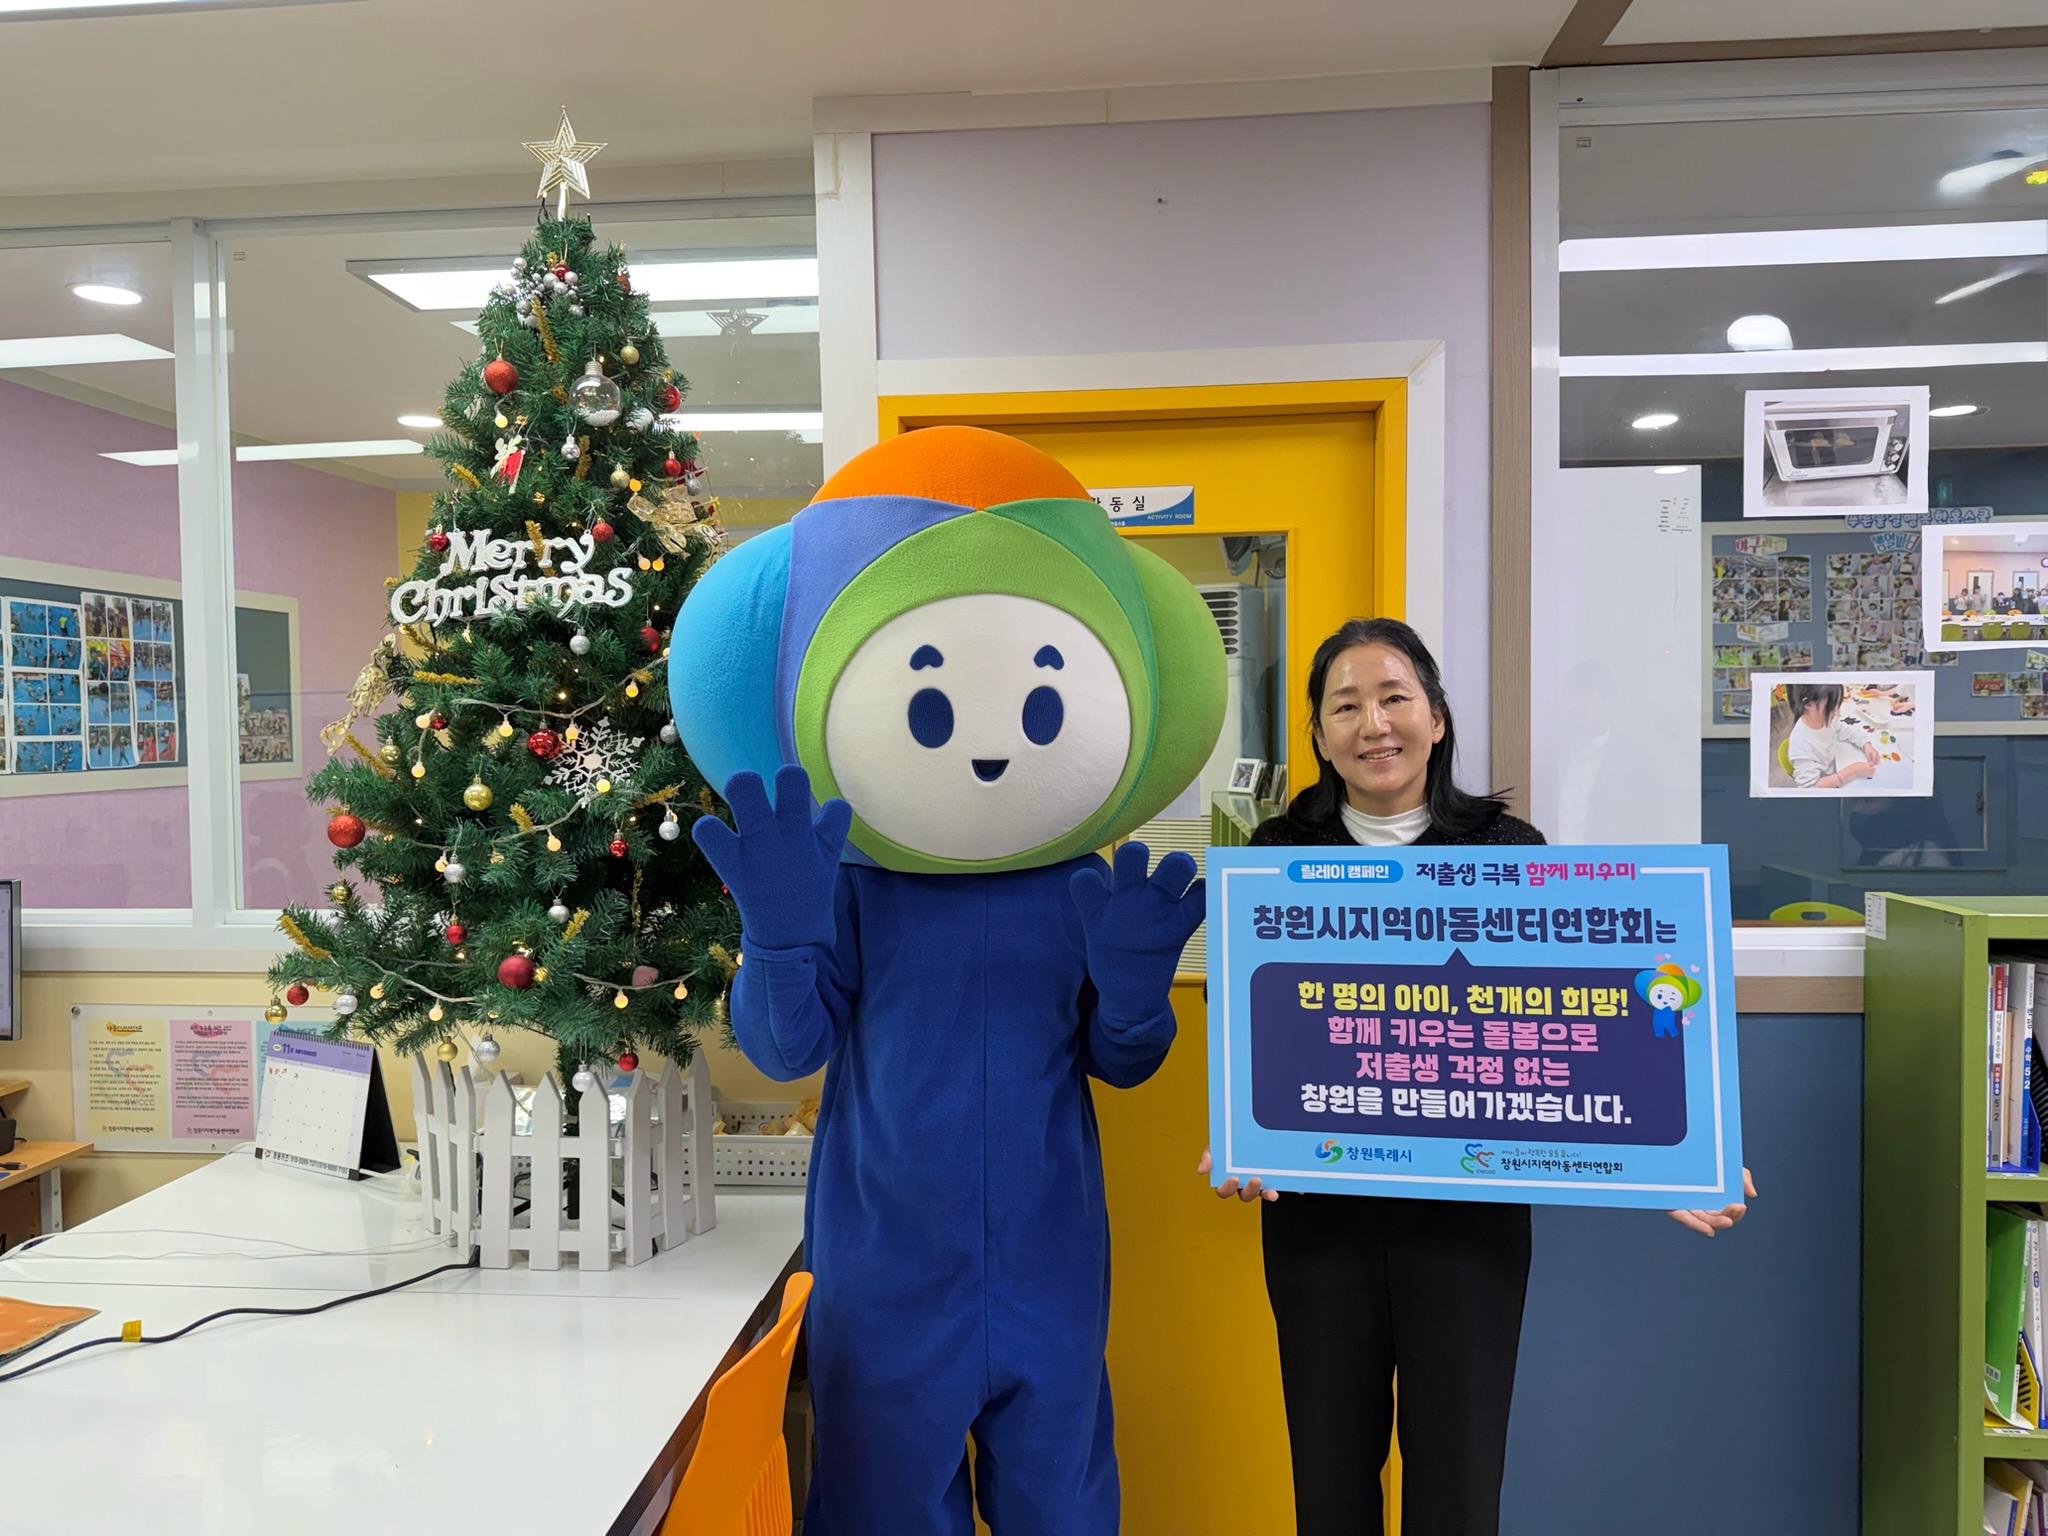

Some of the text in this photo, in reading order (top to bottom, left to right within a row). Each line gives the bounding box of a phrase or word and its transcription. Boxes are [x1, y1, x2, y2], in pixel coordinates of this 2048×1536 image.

[440, 528, 595, 577] Merry
[391, 567, 634, 627] Christmas
[1301, 865, 1389, 879] 릴레이 캠페인
[1417, 862, 1635, 886] 저출생 극복 함께 피우미
[1254, 905, 1676, 944] 창원시지역아동센터연합회는
[1298, 981, 1628, 1016] 한 명의 아이, 천개의 희망!
[1328, 1016, 1598, 1051] 함께 키우는 돌봄으로
[1357, 1052, 1570, 1086] 저출생 걱정 없는
[1301, 1084, 1631, 1124] 창원을 만들어가겠습니다.
[1348, 1147, 1411, 1162] 창원특례시
[1501, 1158, 1623, 1174] 창원시지역아동센터연합회
